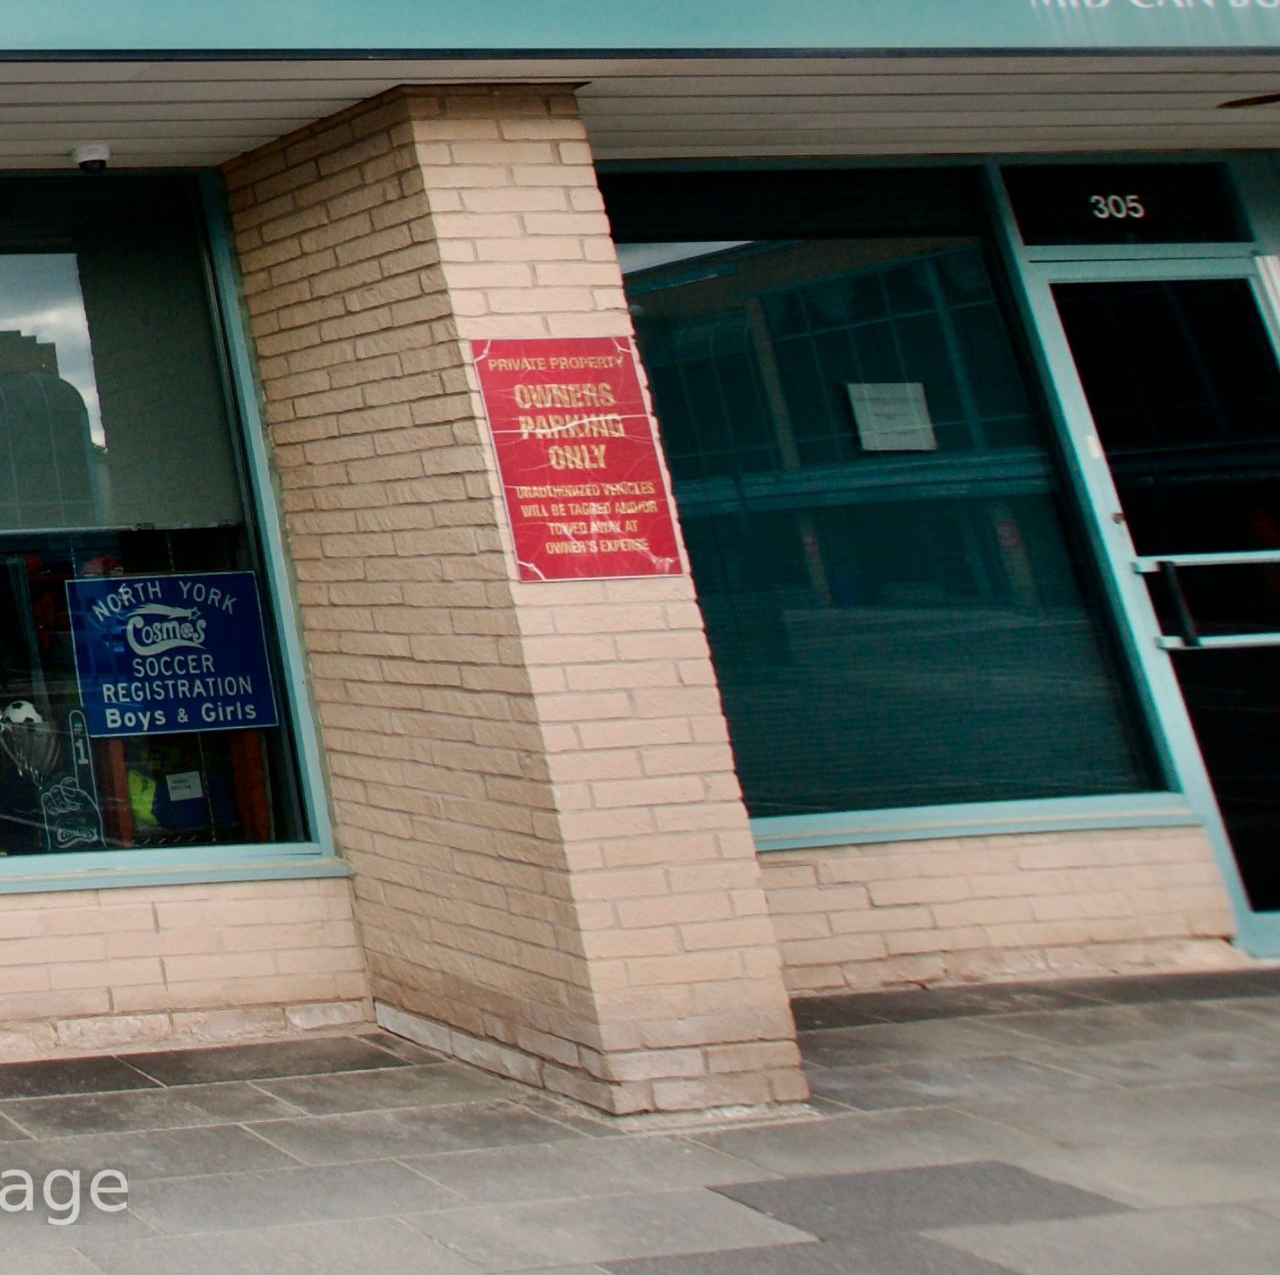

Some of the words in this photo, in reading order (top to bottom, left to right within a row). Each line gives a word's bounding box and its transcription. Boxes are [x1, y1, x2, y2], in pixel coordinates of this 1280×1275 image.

[1089, 195, 1145, 219] 305
[488, 358, 547, 371] PRIVATE
[550, 356, 624, 370] PROPERTY
[513, 383, 616, 409] OWNERS
[518, 412, 626, 439] PARKING
[548, 444, 607, 470] ONLY
[516, 484, 600, 499] UNAUTHORIZED
[603, 481, 656, 495] VEHICLES
[520, 504, 548, 517] WILL
[551, 504, 567, 516] BE
[548, 521, 587, 535] TOWED
[624, 520, 639, 532] AT
[545, 541, 597, 554] OWNER'S
[599, 538, 650, 553] EXPENSE
[92, 580, 162, 622] NORTH
[179, 580, 238, 615] YORK
[132, 654, 216, 678] SOCCER
[102, 676, 254, 704] REGISTRATION
[105, 709, 167, 731] Boys
[177, 708, 189, 723] &
[201, 702, 257, 722] Girls
